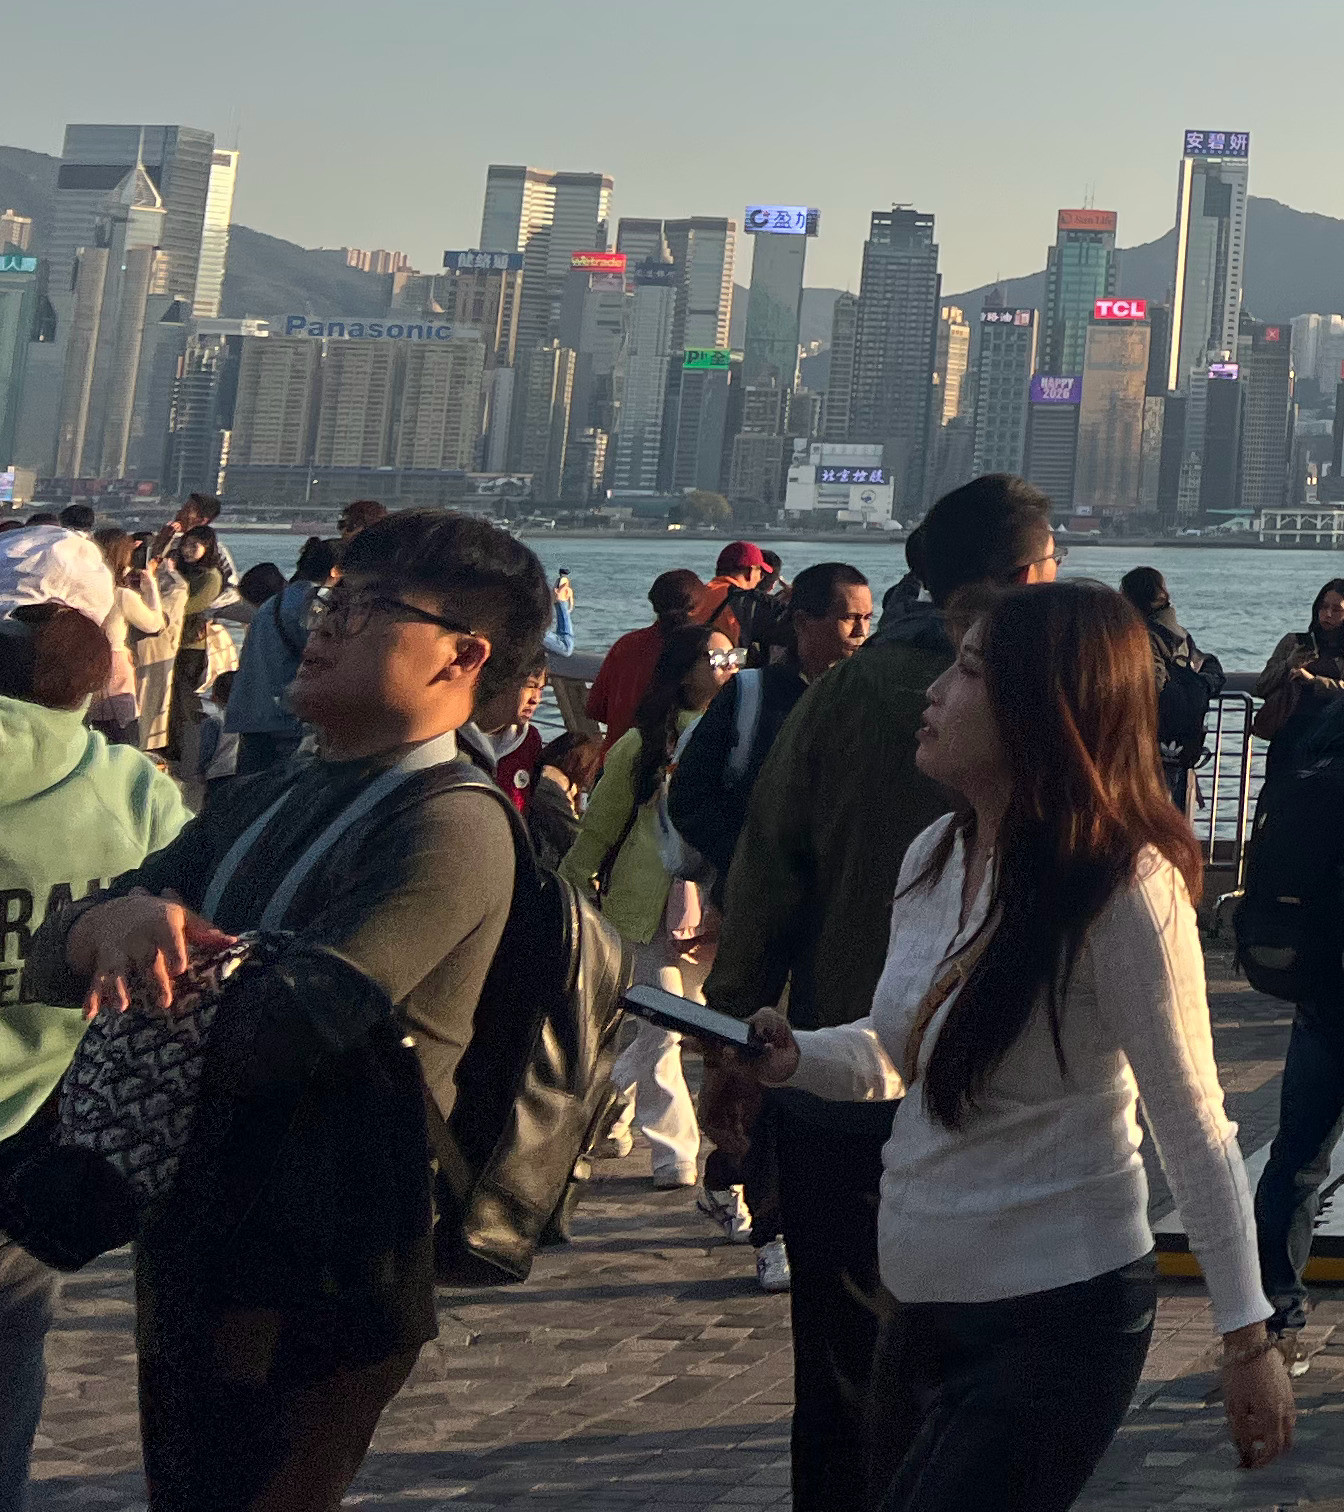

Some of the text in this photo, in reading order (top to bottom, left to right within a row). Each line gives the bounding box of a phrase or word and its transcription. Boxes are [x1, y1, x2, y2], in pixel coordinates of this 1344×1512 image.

[1186, 132, 1247, 150] 安碧妍
[1096, 301, 1145, 317] TCL
[285, 315, 451, 339] Panasonic
[1041, 377, 1074, 389] HAPPY
[1043, 388, 1070, 399] 2026
